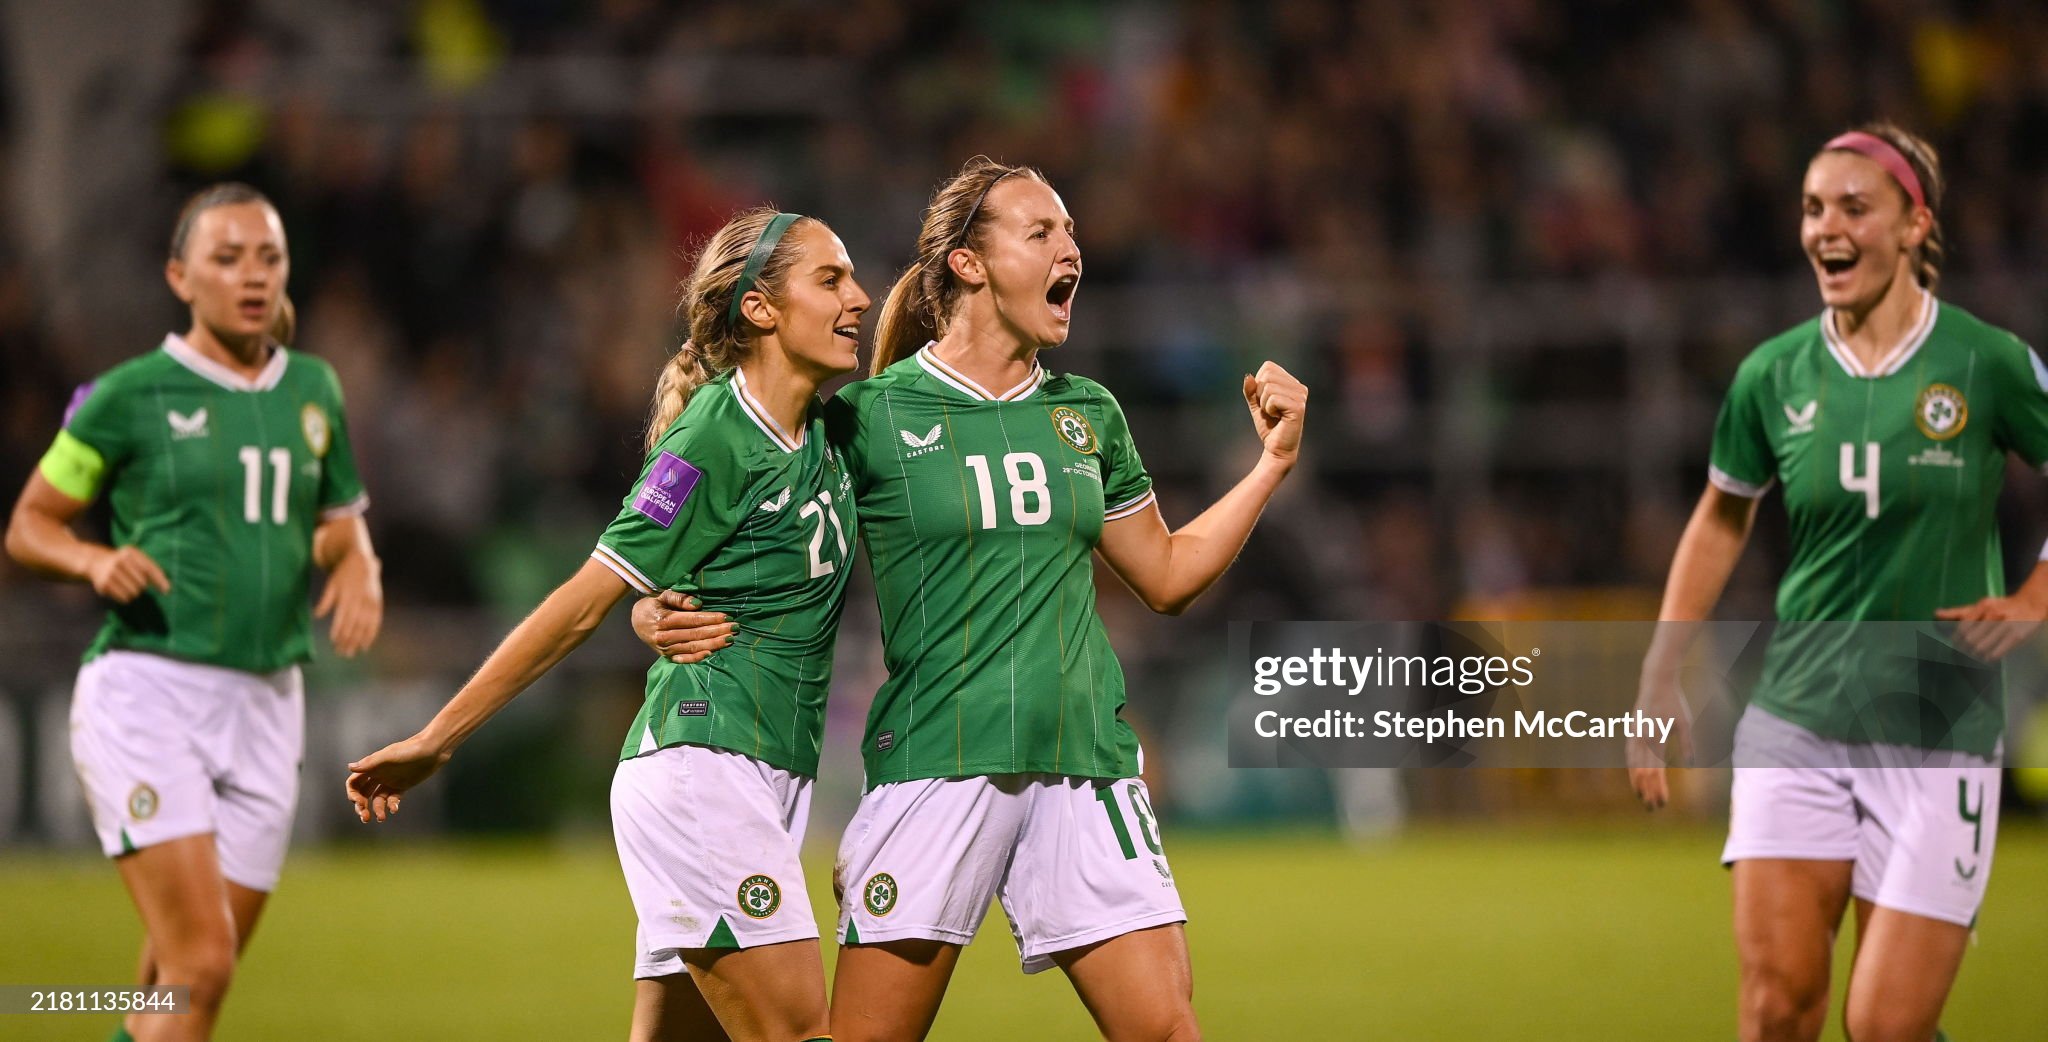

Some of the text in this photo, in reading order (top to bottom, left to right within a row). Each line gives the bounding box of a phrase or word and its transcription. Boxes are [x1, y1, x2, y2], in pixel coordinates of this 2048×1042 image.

[906, 444, 945, 458] CASTORE
[1055, 410, 1087, 428] IRELAND
[239, 446, 291, 525] 11
[641, 491, 674, 514] QUALIFIERS
[644, 486, 676, 508] EUROPEAN
[965, 452, 1052, 530] 18
[1840, 442, 1880, 519] 4
[799, 490, 848, 579] 21
[1095, 784, 1162, 860] 18
[1958, 777, 1984, 855] 4
[740, 877, 774, 896] IRELAND
